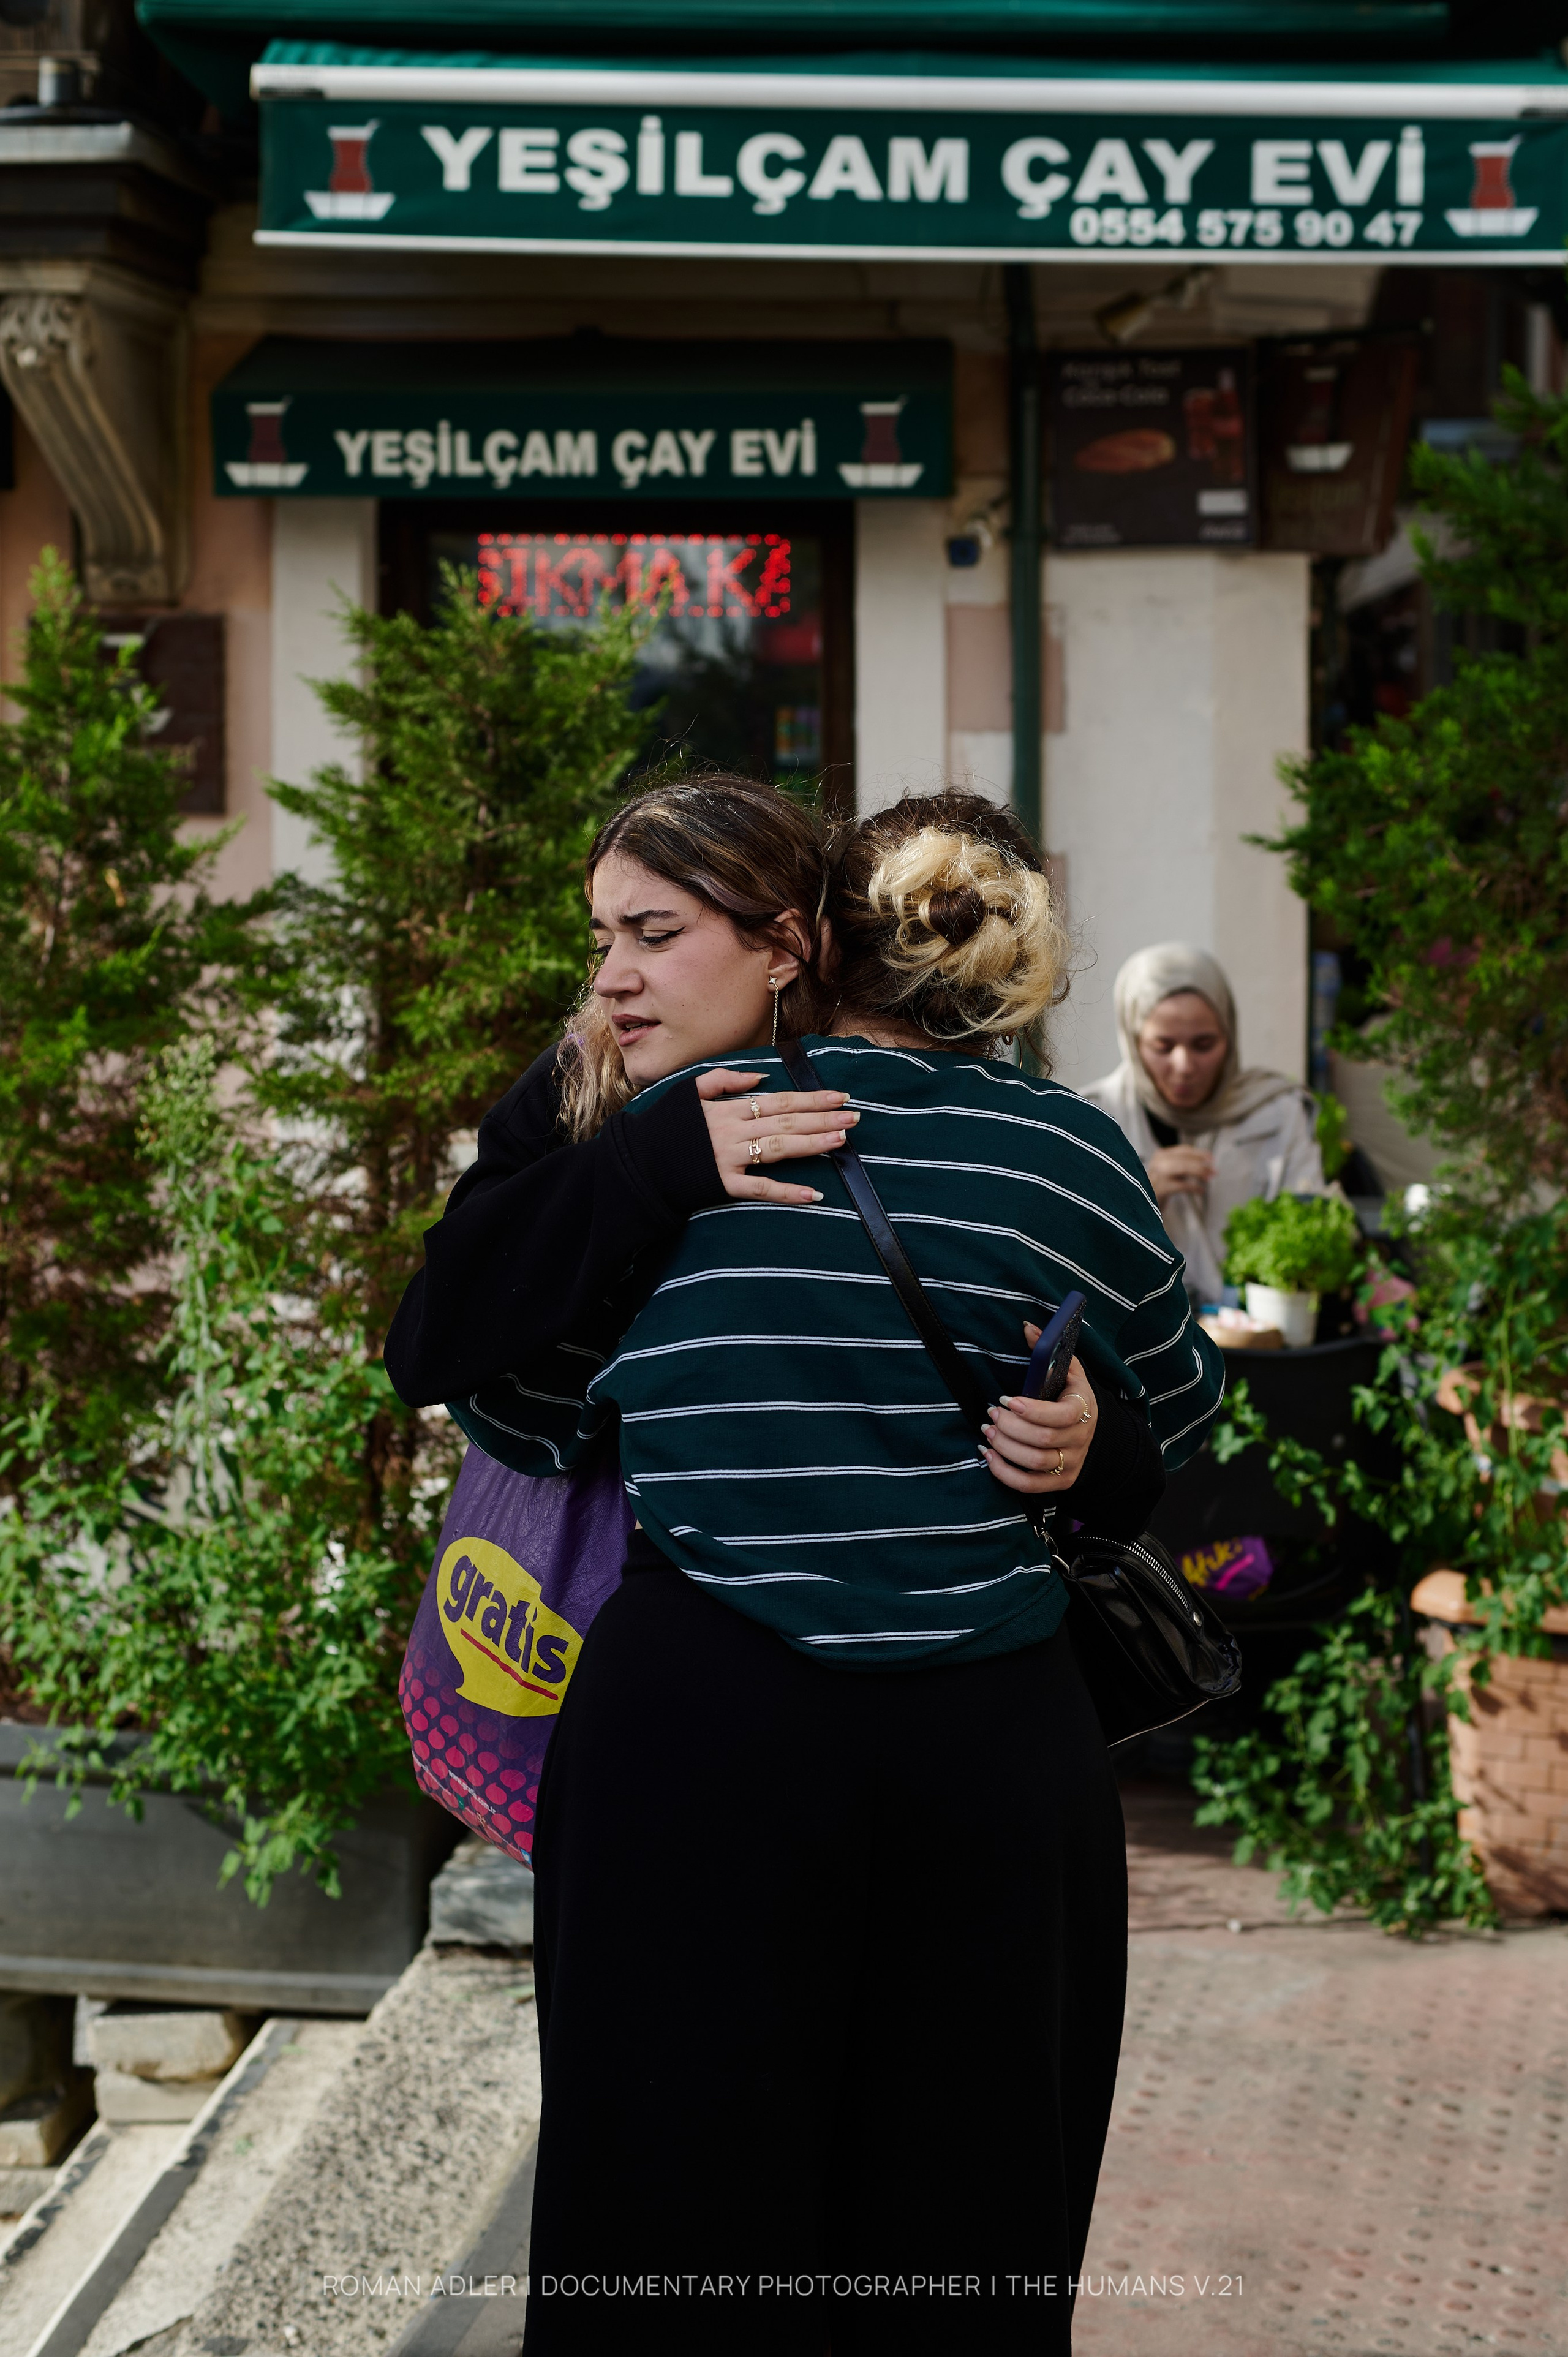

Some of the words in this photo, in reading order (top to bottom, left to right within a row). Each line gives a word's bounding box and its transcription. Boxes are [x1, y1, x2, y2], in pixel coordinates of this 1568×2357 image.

[421, 114, 970, 214] YEŞİLÇAM
[1001, 136, 1216, 219] ÇAY
[1251, 124, 1426, 207] EVİ
[1069, 207, 1186, 246] 0554
[1197, 208, 1283, 246] 575
[1295, 209, 1353, 247] 90
[1364, 211, 1423, 247] 47
[335, 419, 597, 489] YEŞİLÇAM
[612, 429, 715, 489] ÇAY
[731, 418, 816, 477] EVİ
[443, 1555, 569, 1684] gratis
